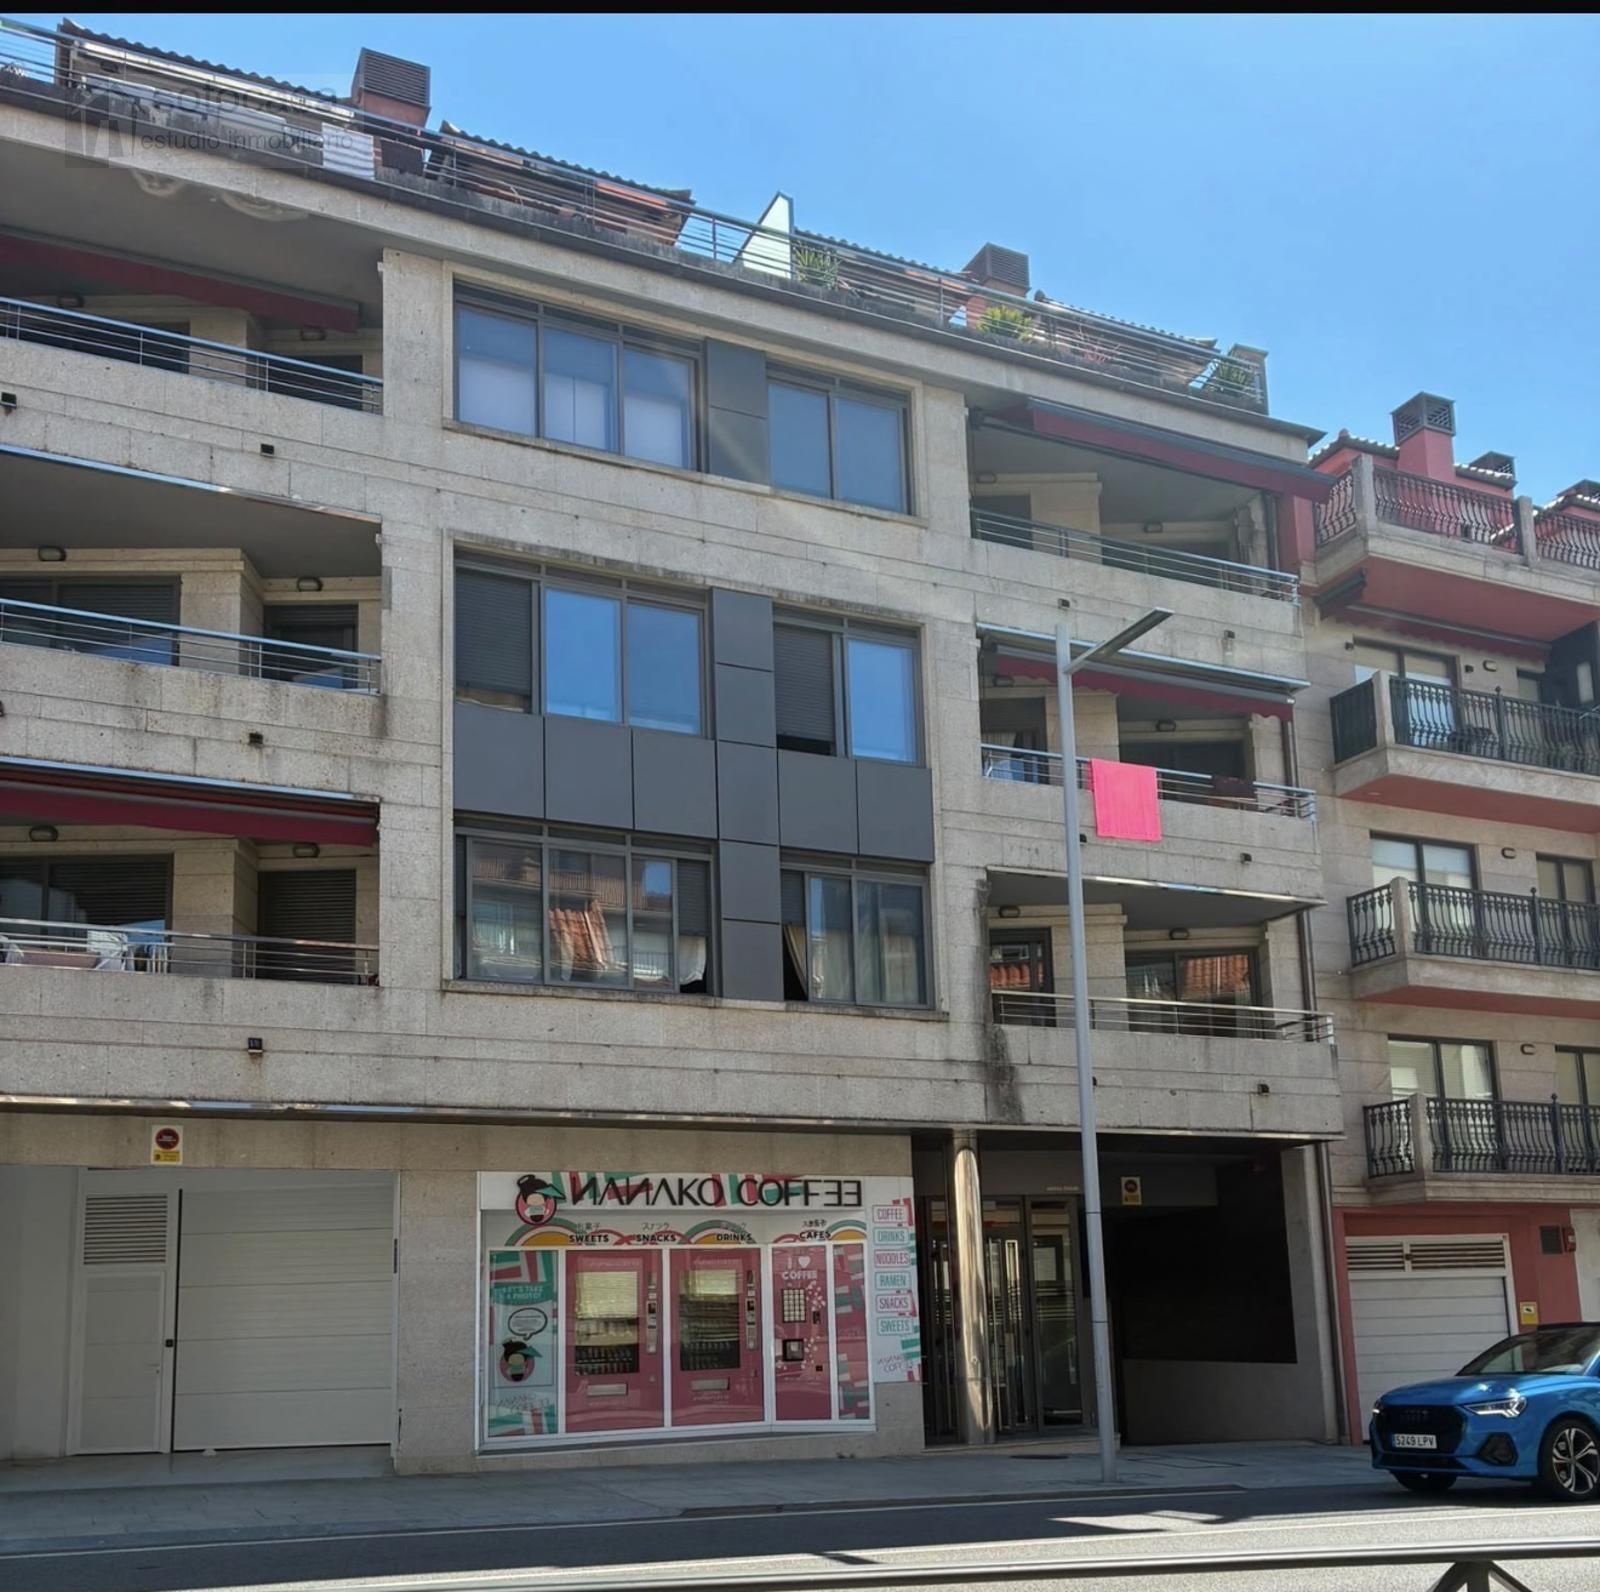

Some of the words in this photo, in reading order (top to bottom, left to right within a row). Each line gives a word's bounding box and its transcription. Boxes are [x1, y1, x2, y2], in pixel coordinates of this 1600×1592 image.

[737, 1178, 863, 1207] COFFEE
[877, 1208, 904, 1220] COFFEE
[569, 1234, 609, 1243] SWEETS
[635, 1234, 676, 1243] SNACKS
[716, 1233, 752, 1242] DRINKS
[878, 1231, 905, 1242] DRINKS
[876, 1253, 910, 1265] NOODLES
[782, 1270, 818, 1280] COFFEE
[879, 1274, 906, 1287] RAMEN
[879, 1297, 909, 1310] SNACKS
[880, 1319, 910, 1333] SWEETS
